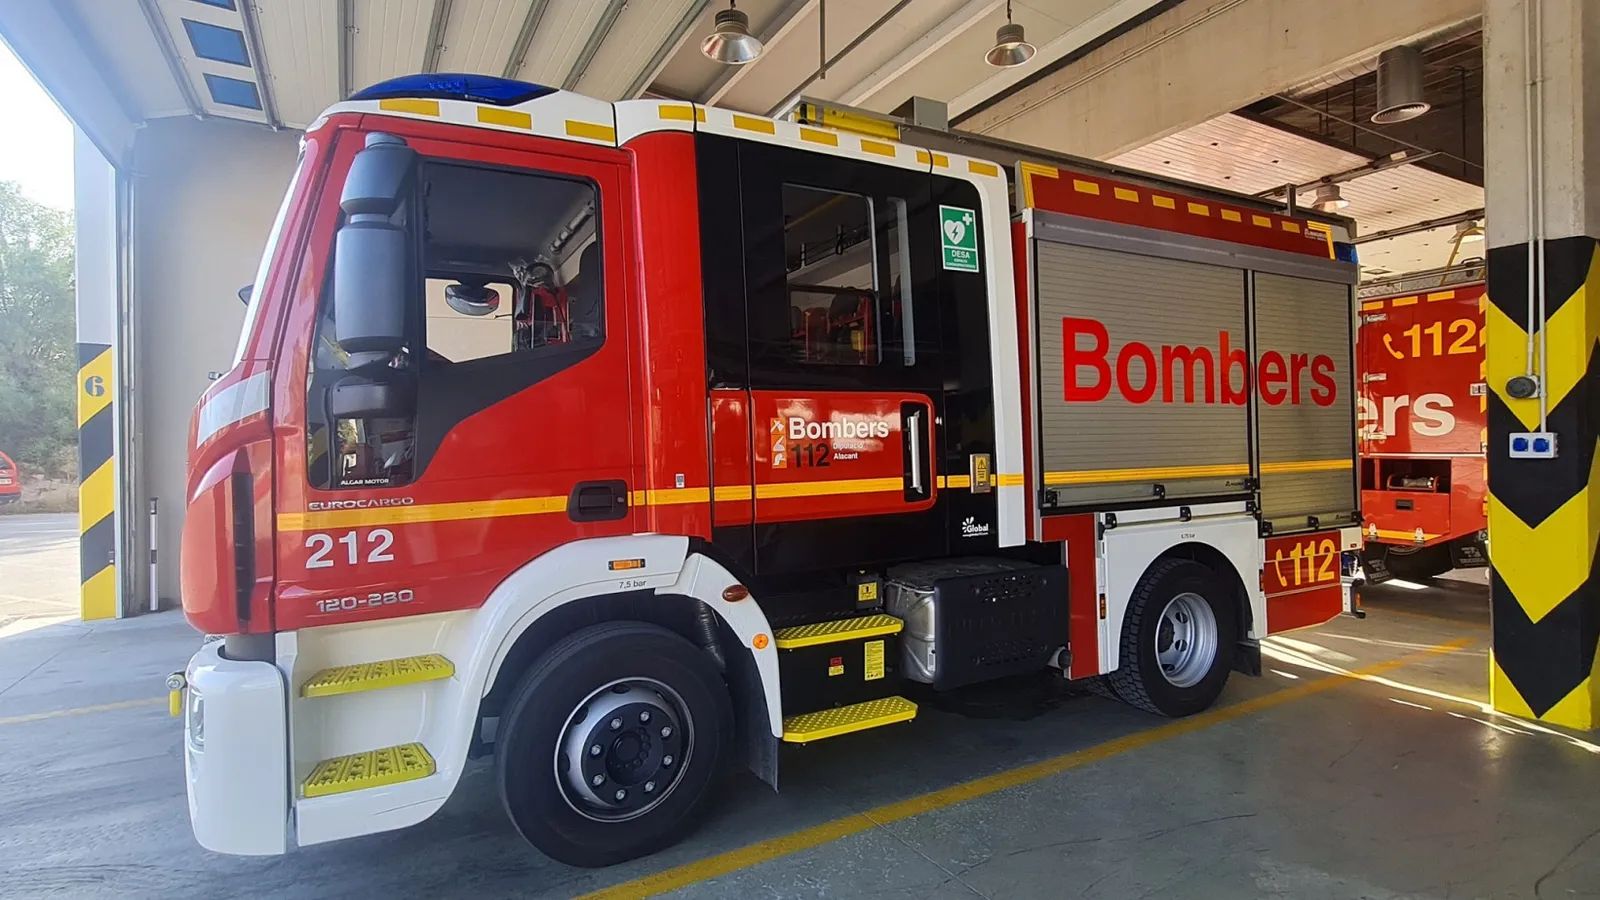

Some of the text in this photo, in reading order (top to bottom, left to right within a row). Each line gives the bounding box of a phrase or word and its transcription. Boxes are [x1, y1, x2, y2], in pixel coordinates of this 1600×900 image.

[952, 250, 970, 258] DESA
[1403, 318, 1477, 357] 112
[1062, 316, 1337, 407] Bombers
[85, 376, 105, 397] 6
[788, 417, 889, 439] Bombers
[791, 443, 831, 468] 112
[309, 497, 414, 510] EUROCARGO
[966, 523, 989, 534] Global
[305, 528, 395, 569] 212
[1290, 538, 1336, 586] 112
[316, 589, 414, 613] 120-280
